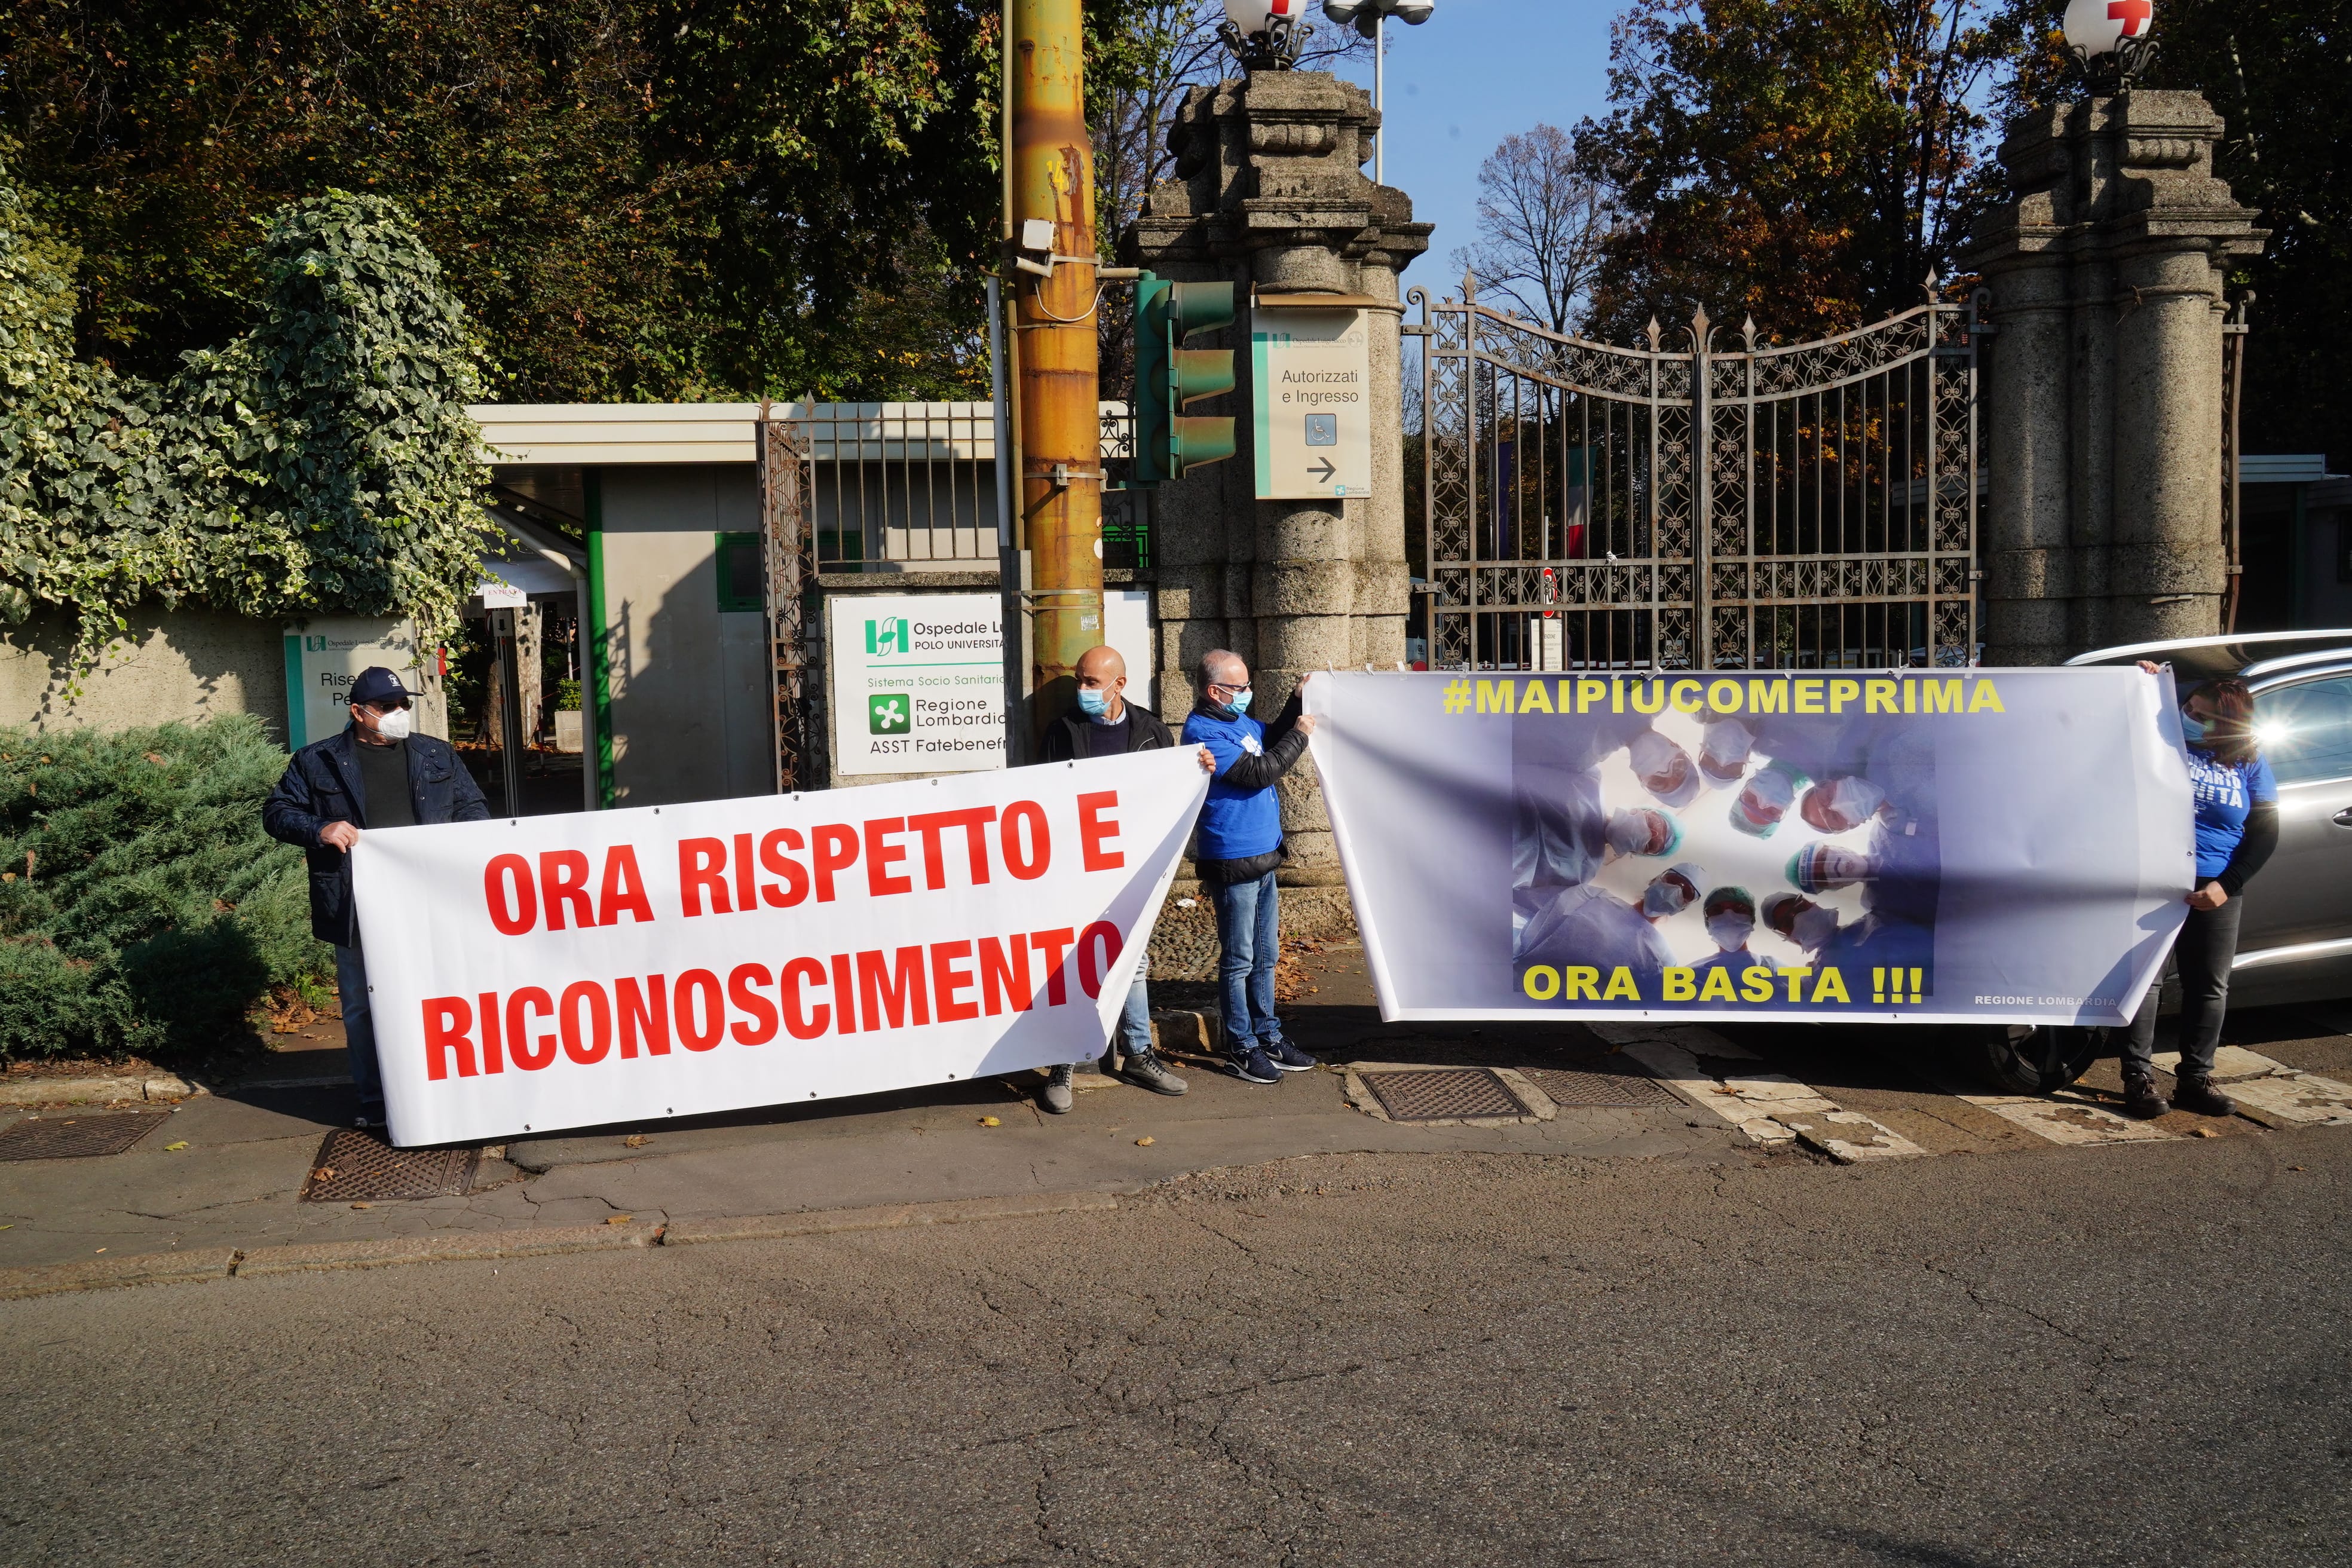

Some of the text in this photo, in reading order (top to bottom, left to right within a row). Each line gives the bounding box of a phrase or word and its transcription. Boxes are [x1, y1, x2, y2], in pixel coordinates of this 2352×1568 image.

[1282, 369, 1358, 382] Autorizzati
[1282, 390, 1358, 406] e Ingresso
[914, 621, 987, 637] Ospedale
[915, 641, 944, 650] POLO
[321, 673, 359, 685] Rise
[868, 677, 914, 687] Sistema
[918, 676, 950, 686] Socio
[1443, 679, 2005, 714] #MAIPIUCOMEPRIMA
[916, 699, 987, 714] Regione
[870, 740, 910, 754] ASST
[484, 790, 1125, 936] ORA RISPETTO E
[1523, 964, 1922, 1004] ORA BASTA !!!
[421, 921, 1123, 1081] RICONOSCIMENTO
[1975, 995, 2117, 1007] REGIONE LOMBARDIA
